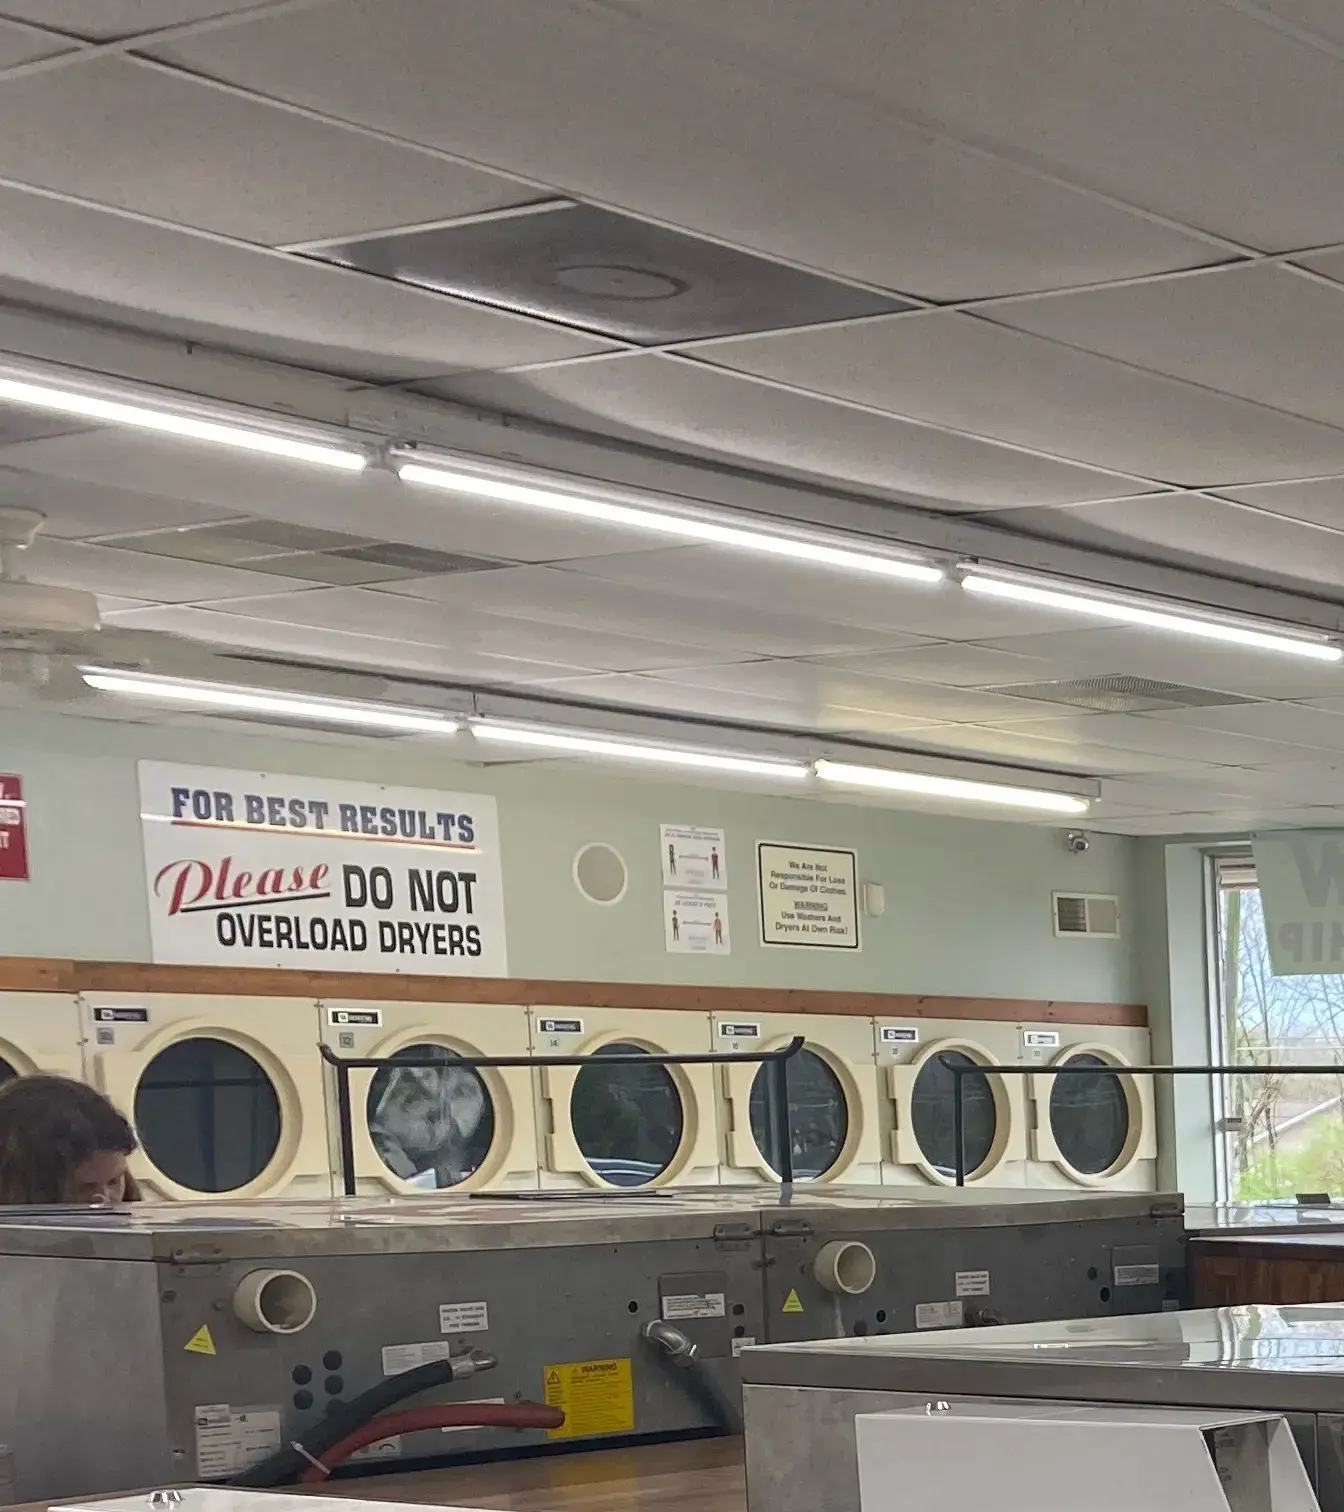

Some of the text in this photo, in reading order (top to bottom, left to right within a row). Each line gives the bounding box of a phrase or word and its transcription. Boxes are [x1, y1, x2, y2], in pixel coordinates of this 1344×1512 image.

[171, 787, 475, 843] FOR BEST RESULTS
[154, 856, 477, 916] Please DO NOT
[216, 911, 482, 957] OVERLOAD DRYERS
